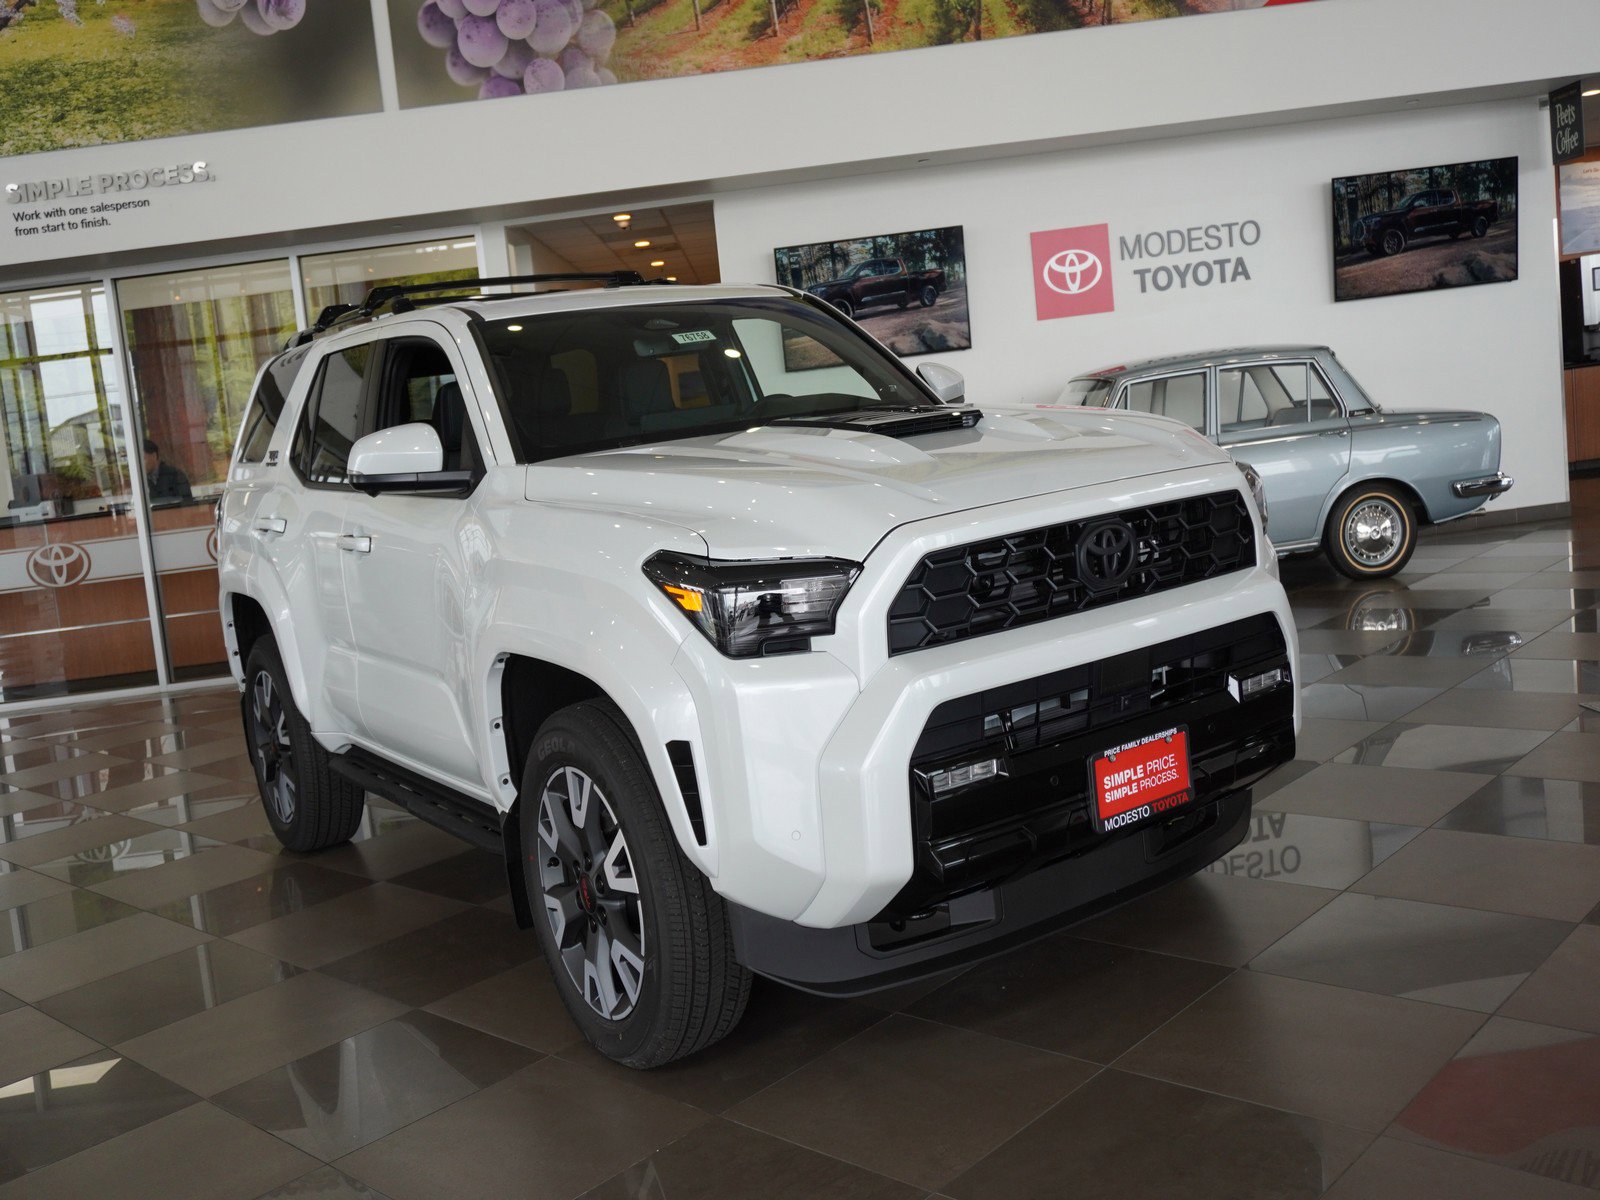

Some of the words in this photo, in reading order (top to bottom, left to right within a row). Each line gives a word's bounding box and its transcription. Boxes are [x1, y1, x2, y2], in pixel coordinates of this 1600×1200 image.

[1555, 103, 1576, 128] Peet's
[1555, 127, 1579, 154] Coffee
[5, 175, 94, 204] SIMPLE
[99, 161, 216, 194] PROCESS.
[13, 210, 42, 222] Work
[43, 206, 66, 218] with
[69, 206, 88, 216] one
[90, 199, 150, 214] salesperson
[14, 225, 39, 237] from
[41, 221, 65, 234] start
[67, 220, 79, 230] to
[80, 216, 111, 229] finish.
[1119, 219, 1261, 261] MODESTO
[1133, 256, 1252, 293] TOYOTA
[678, 331, 710, 342] 76758
[1104, 745, 1121, 758] PRICE
[1121, 739, 1141, 752] FAMILY
[1141, 727, 1178, 744] DEALERSHIPS
[1103, 764, 1144, 789] SIMPLE
[1146, 754, 1178, 775] PRICE.
[1104, 783, 1139, 803] SIMPLE
[1140, 769, 1179, 791] PROCESS.
[1104, 805, 1150, 831] MODESTO
[1151, 791, 1189, 813] TOYOTA
